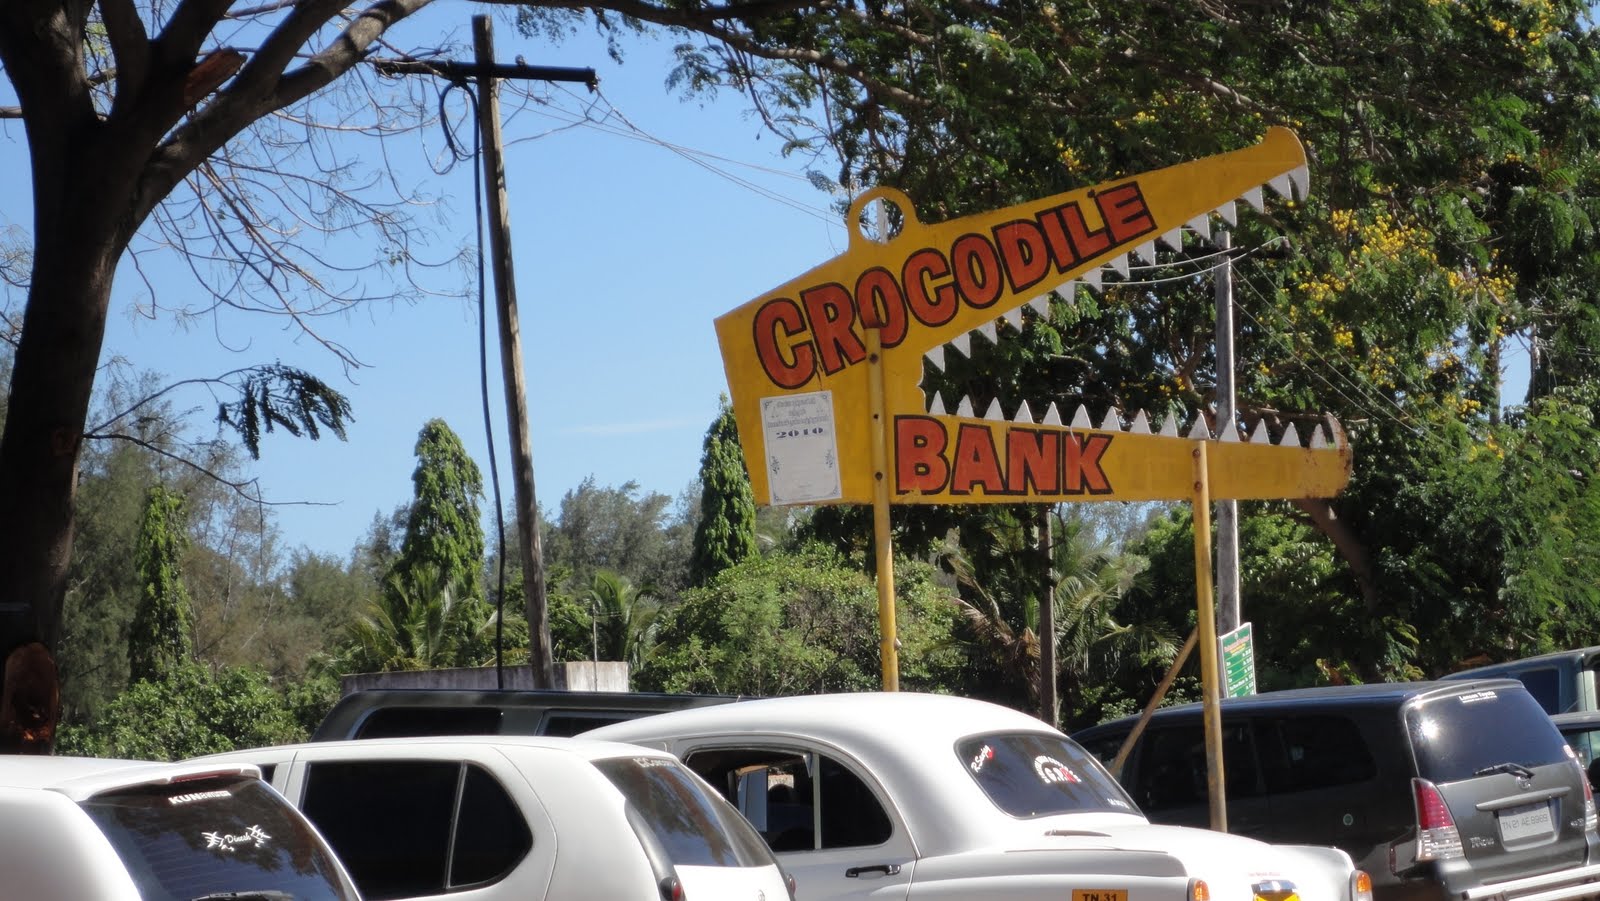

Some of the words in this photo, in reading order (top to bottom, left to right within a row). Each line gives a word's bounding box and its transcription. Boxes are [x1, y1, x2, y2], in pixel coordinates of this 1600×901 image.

[752, 180, 1158, 390] CROCODILE
[776, 427, 824, 439] 2010
[893, 414, 1114, 496] BANK
